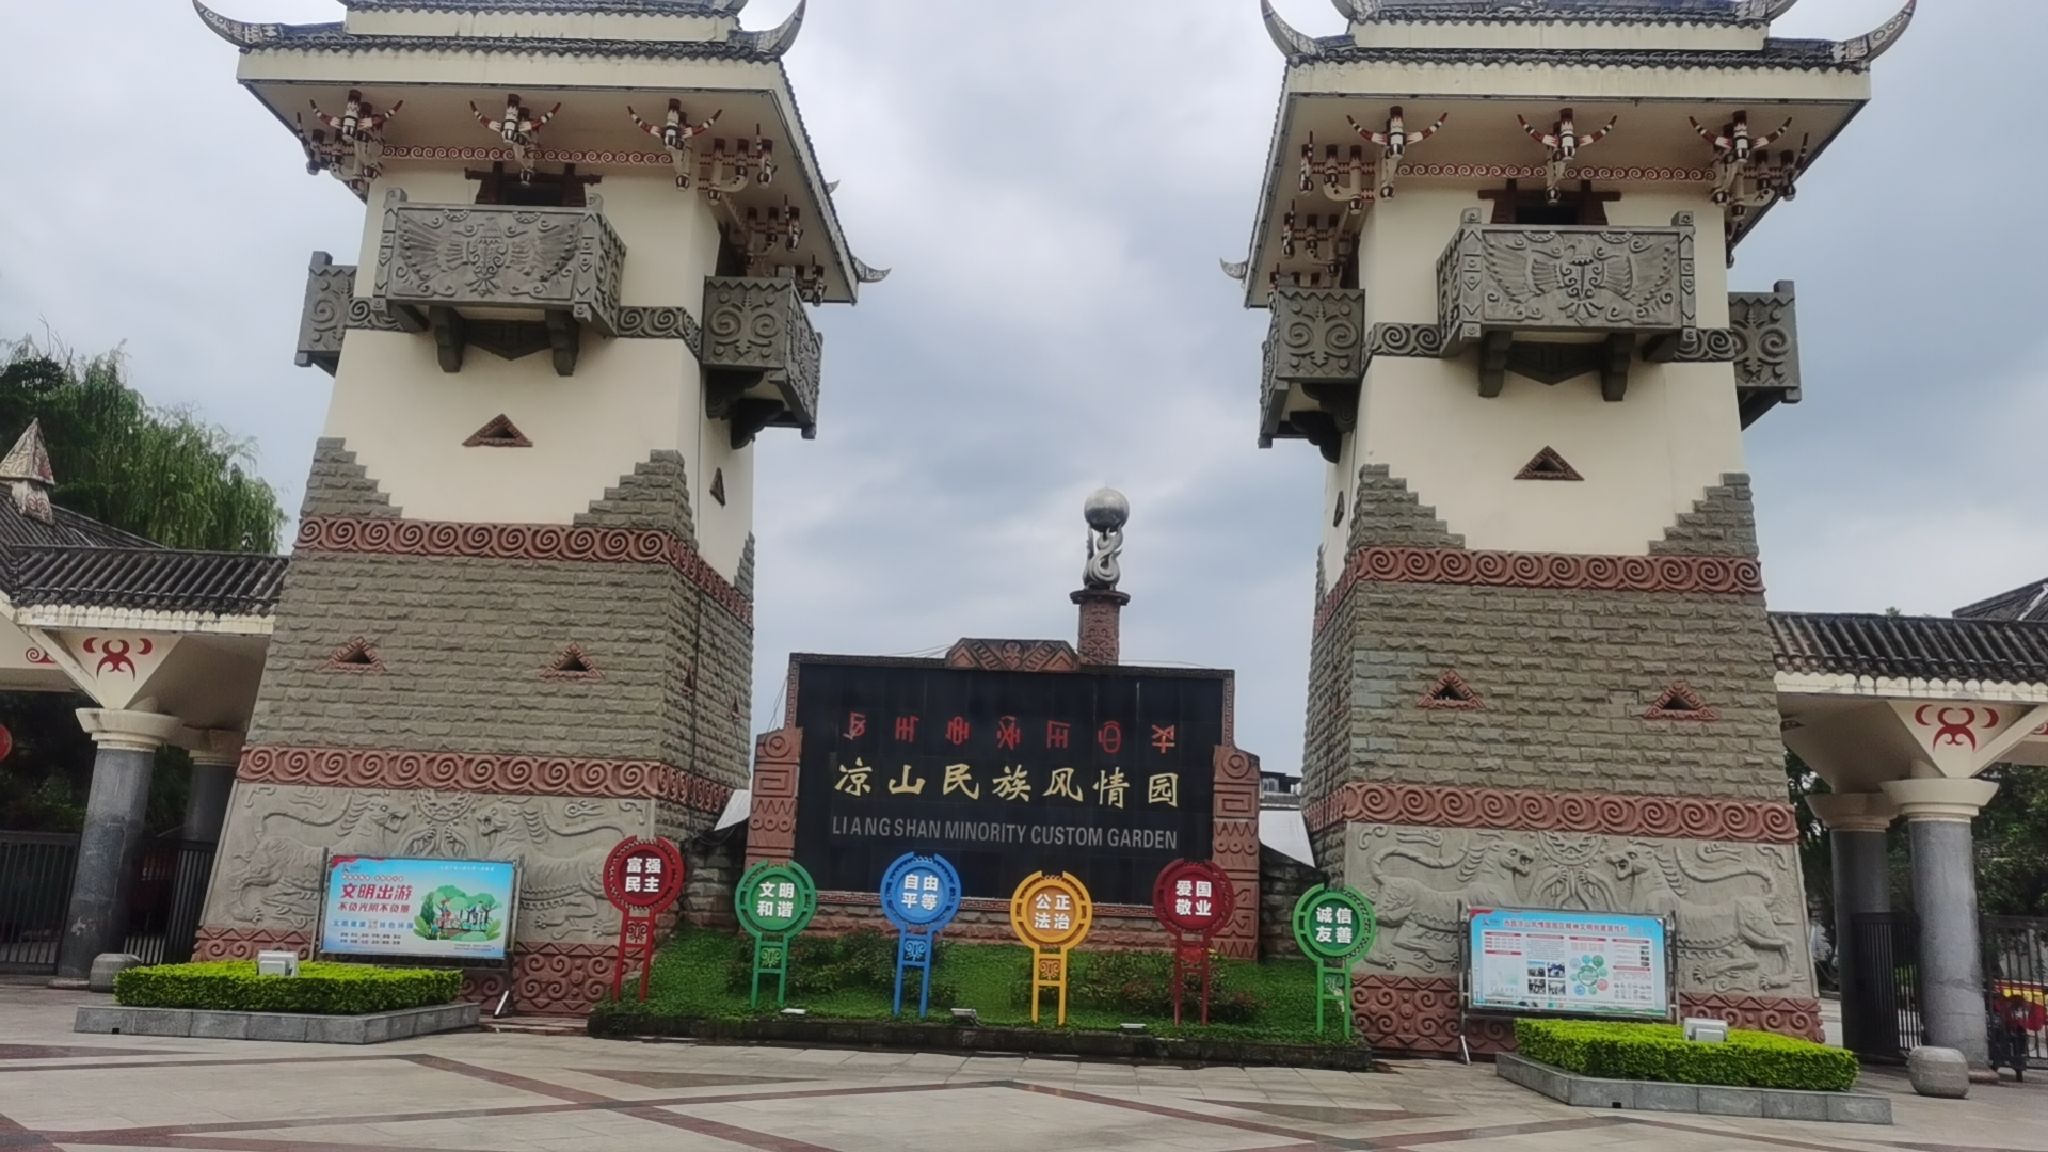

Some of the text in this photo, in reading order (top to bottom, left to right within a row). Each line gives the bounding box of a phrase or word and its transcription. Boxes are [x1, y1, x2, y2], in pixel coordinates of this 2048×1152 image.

[834, 756, 1179, 808] 凉山民族风情园
[832, 815, 1178, 850] LIANGSHAN MINORITY CUSTOM GARDEN
[627, 858, 661, 874] 富强
[625, 876, 659, 893] 民主
[758, 881, 796, 898] 文明
[904, 874, 939, 891] 自由
[1177, 881, 1212, 897] 爱国
[341, 883, 413, 900] 文明出游
[756, 900, 794, 918] 和谐
[901, 893, 938, 910] 平等
[1035, 894, 1071, 911] 公正
[1175, 899, 1212, 916] 敬业
[1034, 913, 1070, 930] 法治
[1316, 907, 1352, 923] 诚信
[1315, 925, 1351, 944] 友善
